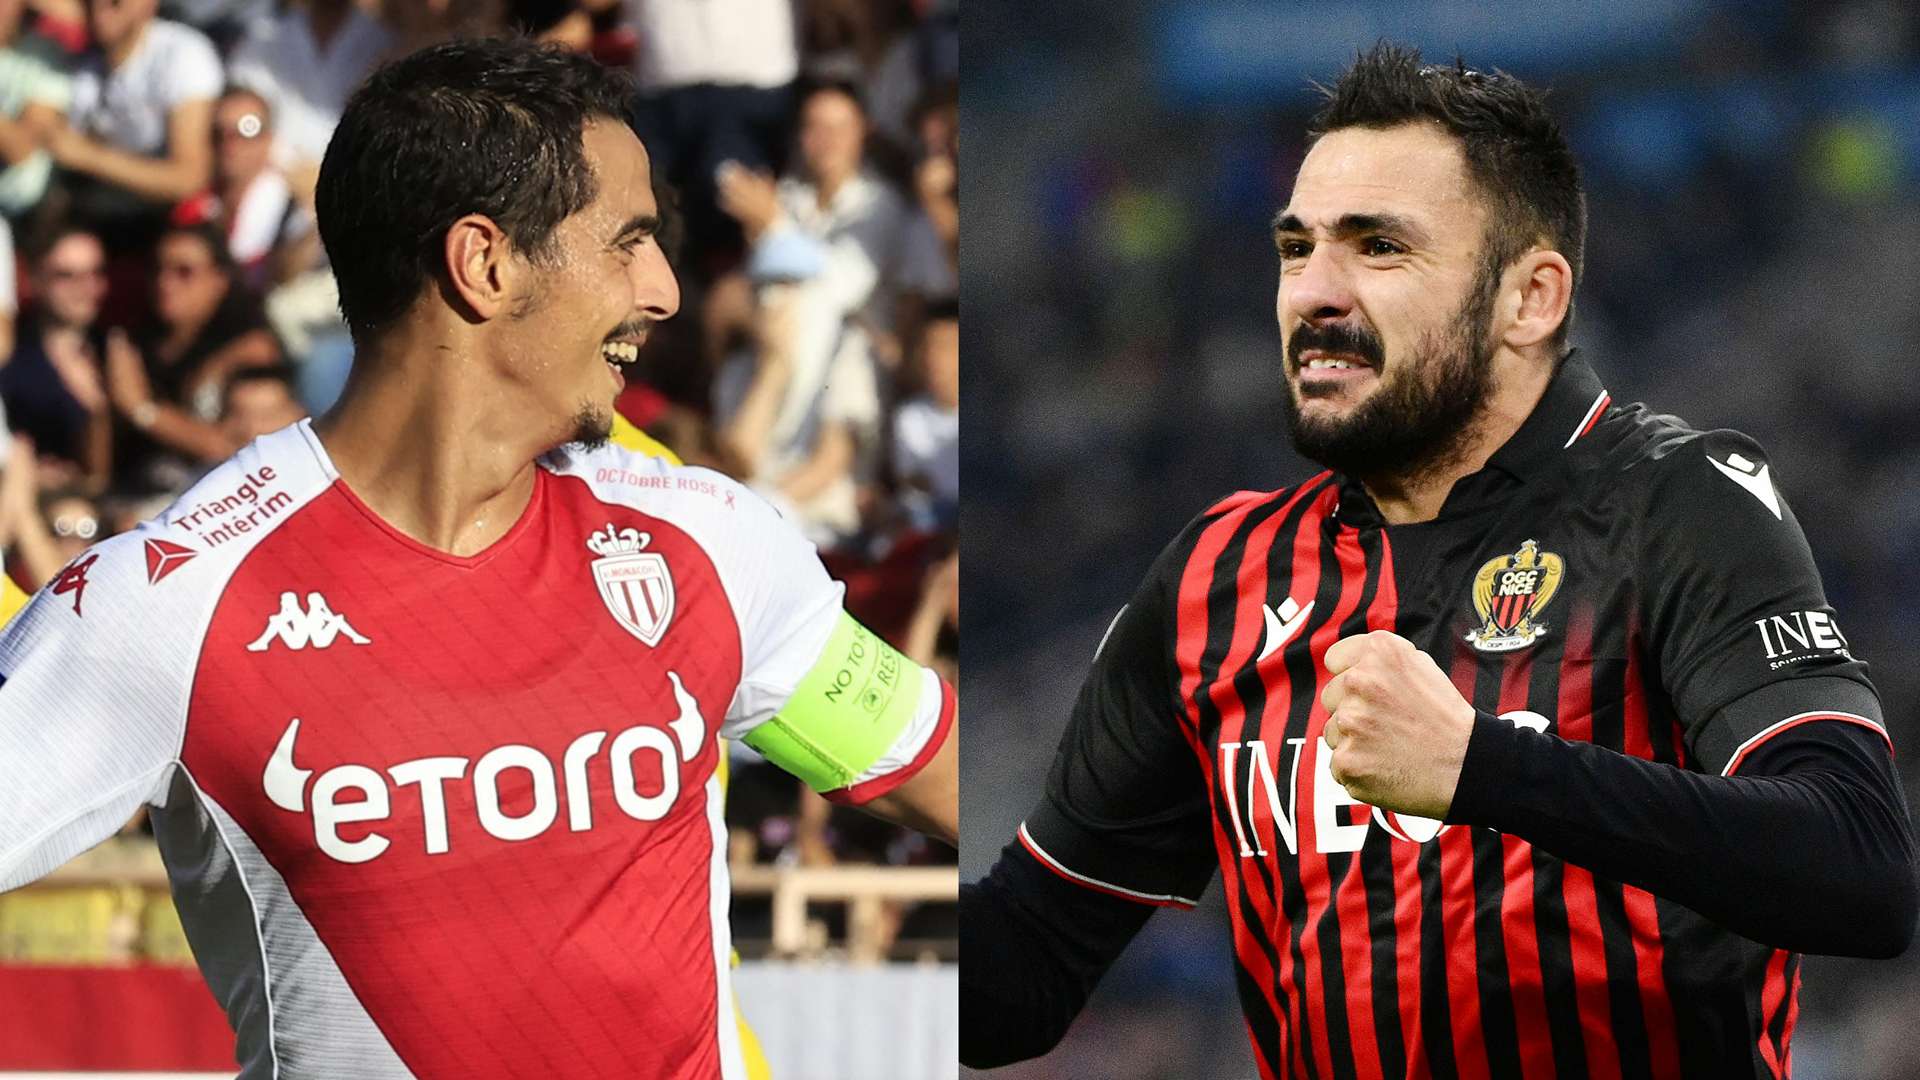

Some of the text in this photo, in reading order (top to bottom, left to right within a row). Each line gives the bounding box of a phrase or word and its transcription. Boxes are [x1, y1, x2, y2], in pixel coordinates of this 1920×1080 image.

[172, 464, 277, 533] Triangle
[596, 468, 718, 497] OCTOBRE ROSE
[199, 489, 293, 548] intérim
[1499, 583, 1534, 596] NICE
[1502, 571, 1538, 585] OGC
[1755, 610, 1848, 658] INE
[824, 669, 852, 703] NO
[847, 642, 865, 666] TO
